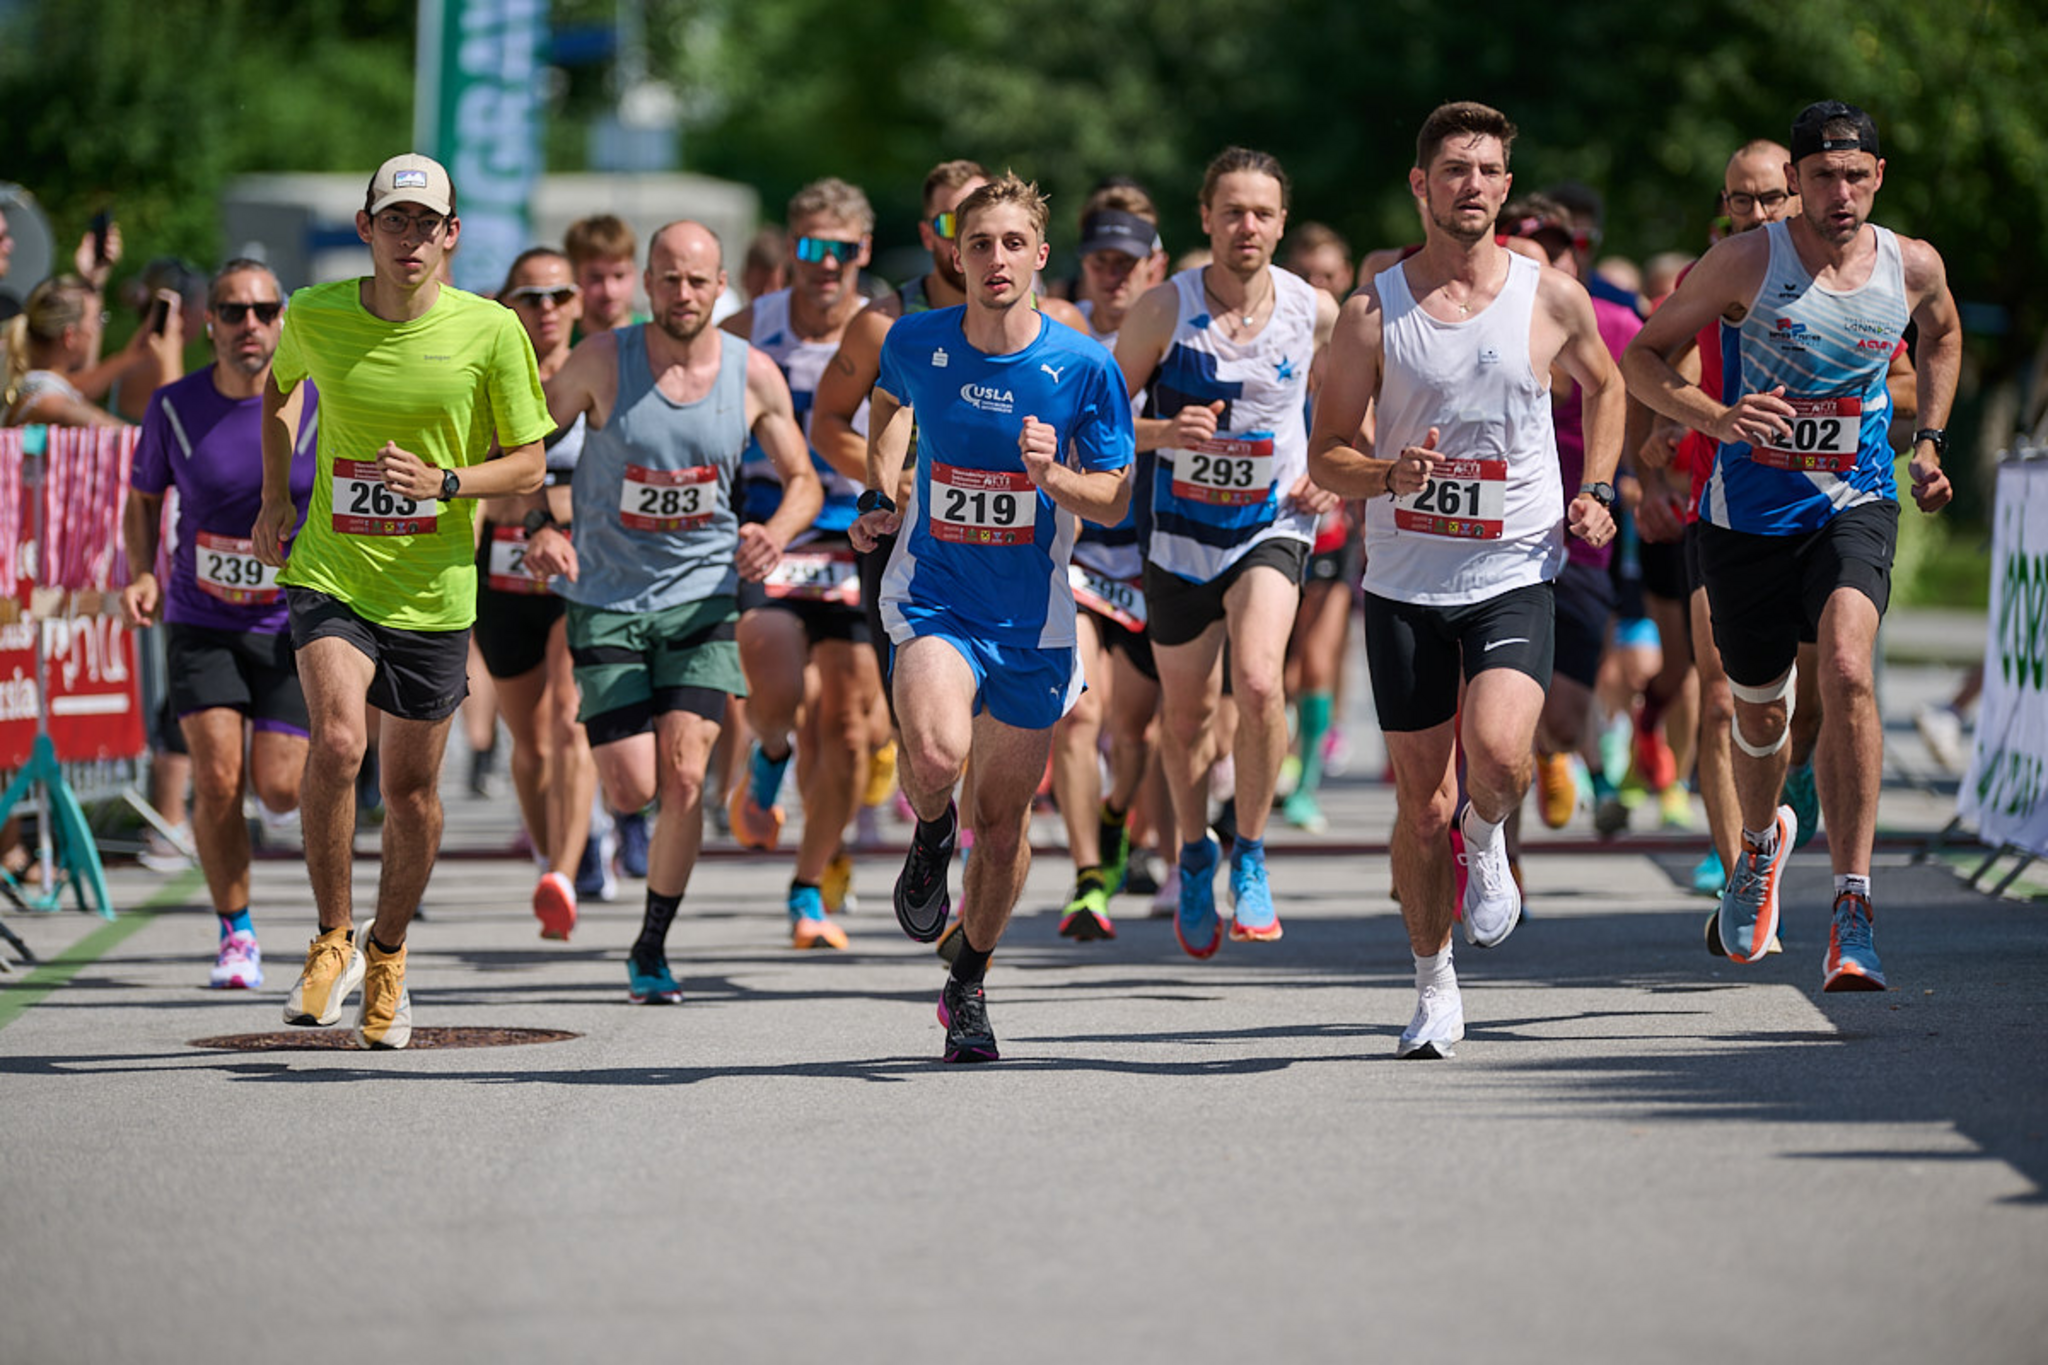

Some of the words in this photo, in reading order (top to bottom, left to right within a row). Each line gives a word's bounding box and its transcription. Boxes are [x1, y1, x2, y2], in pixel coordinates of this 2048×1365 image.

[973, 386, 1015, 403] USLA
[1190, 454, 1254, 487] 293
[638, 486, 700, 515] 283
[944, 488, 1017, 526] 219
[1412, 478, 1481, 516] 261
[208, 552, 264, 586] 239
